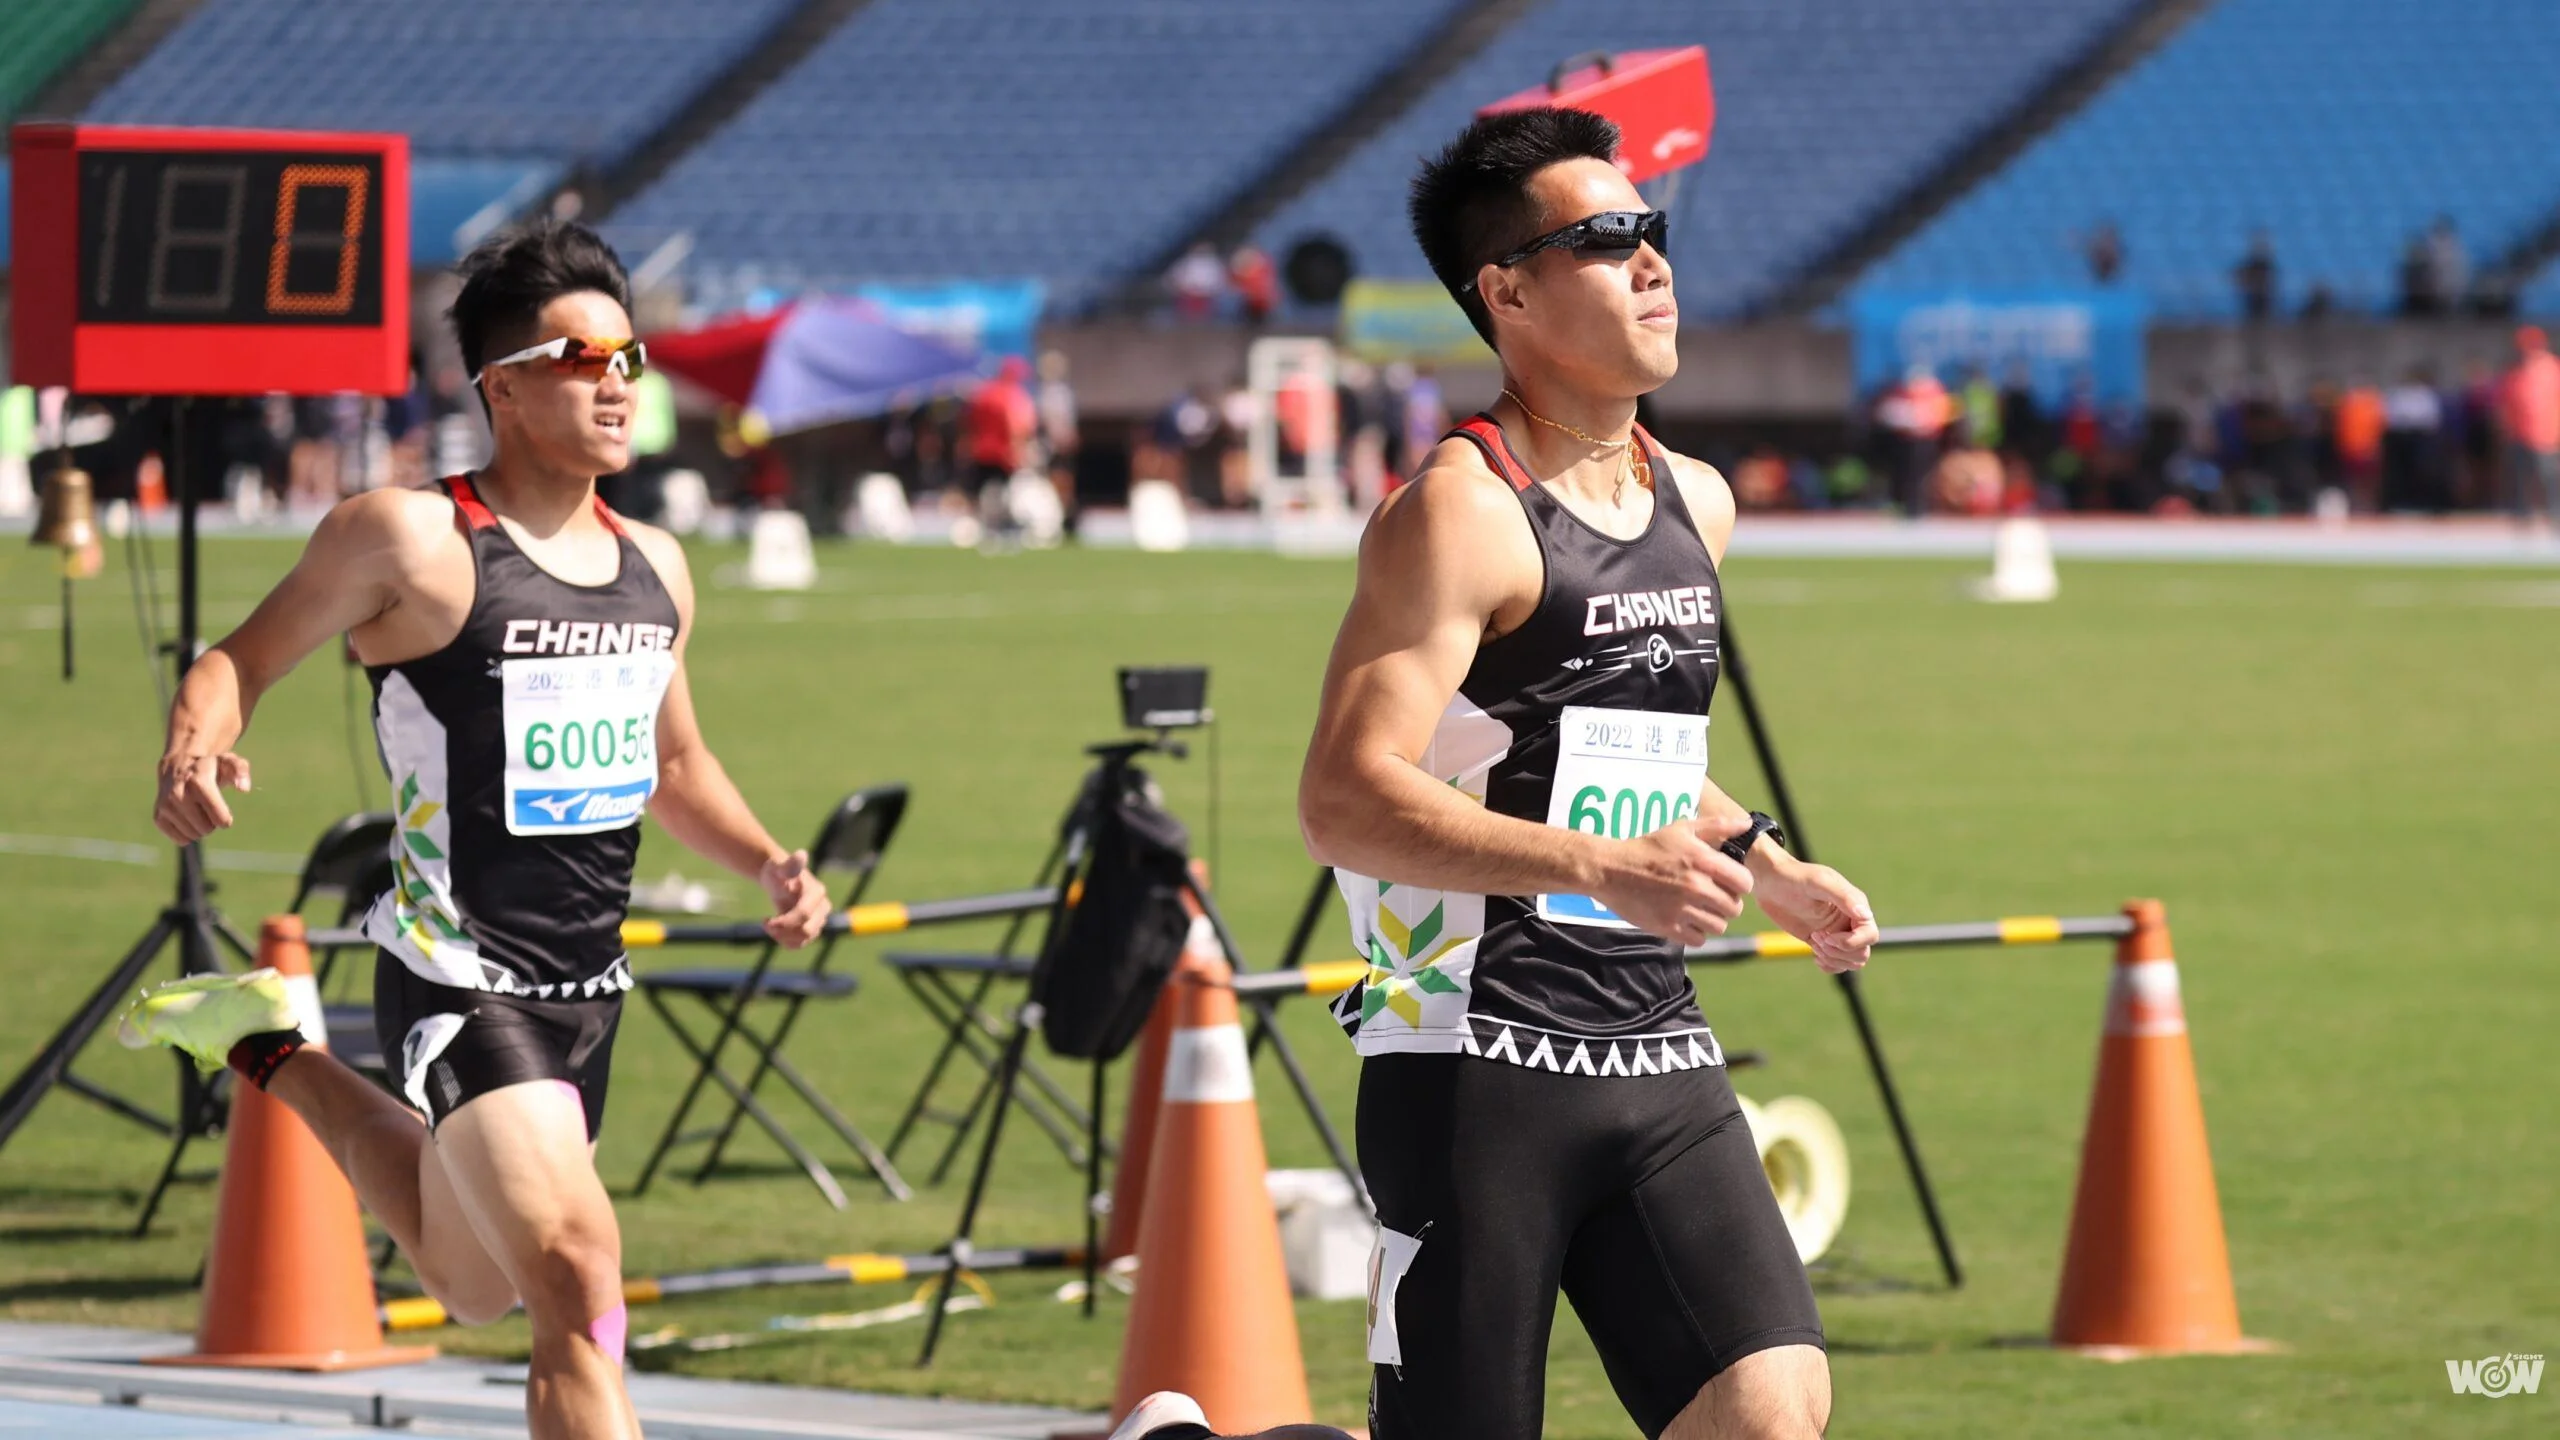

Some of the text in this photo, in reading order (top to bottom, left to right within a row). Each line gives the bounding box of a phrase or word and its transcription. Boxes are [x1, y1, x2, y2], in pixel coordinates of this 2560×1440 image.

[502, 619, 674, 654] CHANGE
[1583, 586, 1716, 637] CHANGE
[524, 713, 649, 771] 60056
[1584, 722, 1633, 749] 2022
[1568, 785, 1700, 840] 6006
